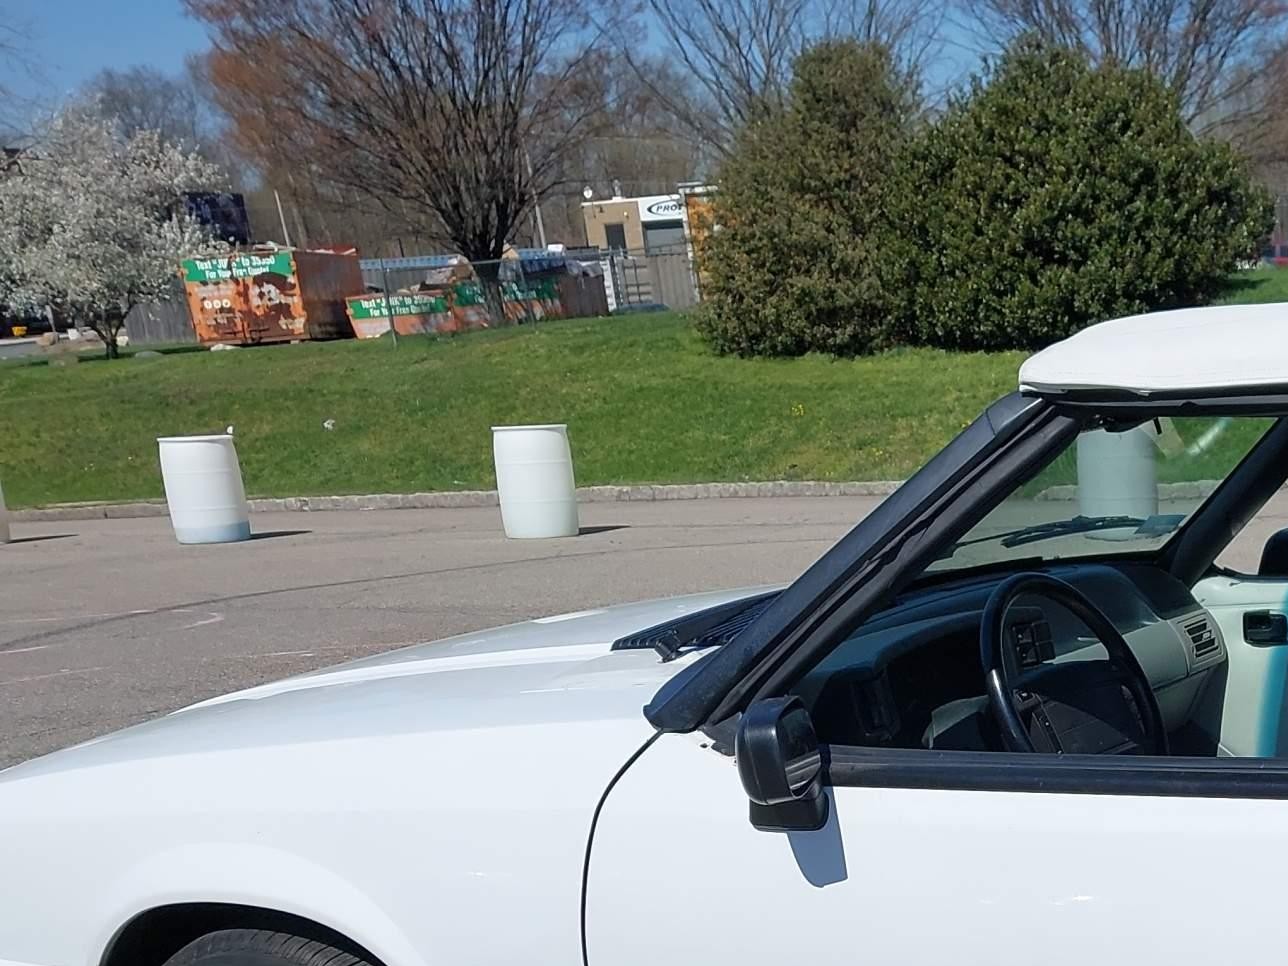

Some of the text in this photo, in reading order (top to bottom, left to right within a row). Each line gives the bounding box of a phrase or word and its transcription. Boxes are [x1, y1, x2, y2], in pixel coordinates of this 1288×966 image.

[196, 260, 212, 270] Text
[241, 256, 250, 266] to
[205, 270, 216, 279] For
[360, 299, 376, 309] Text
[404, 296, 412, 305] to
[370, 308, 380, 317] For
